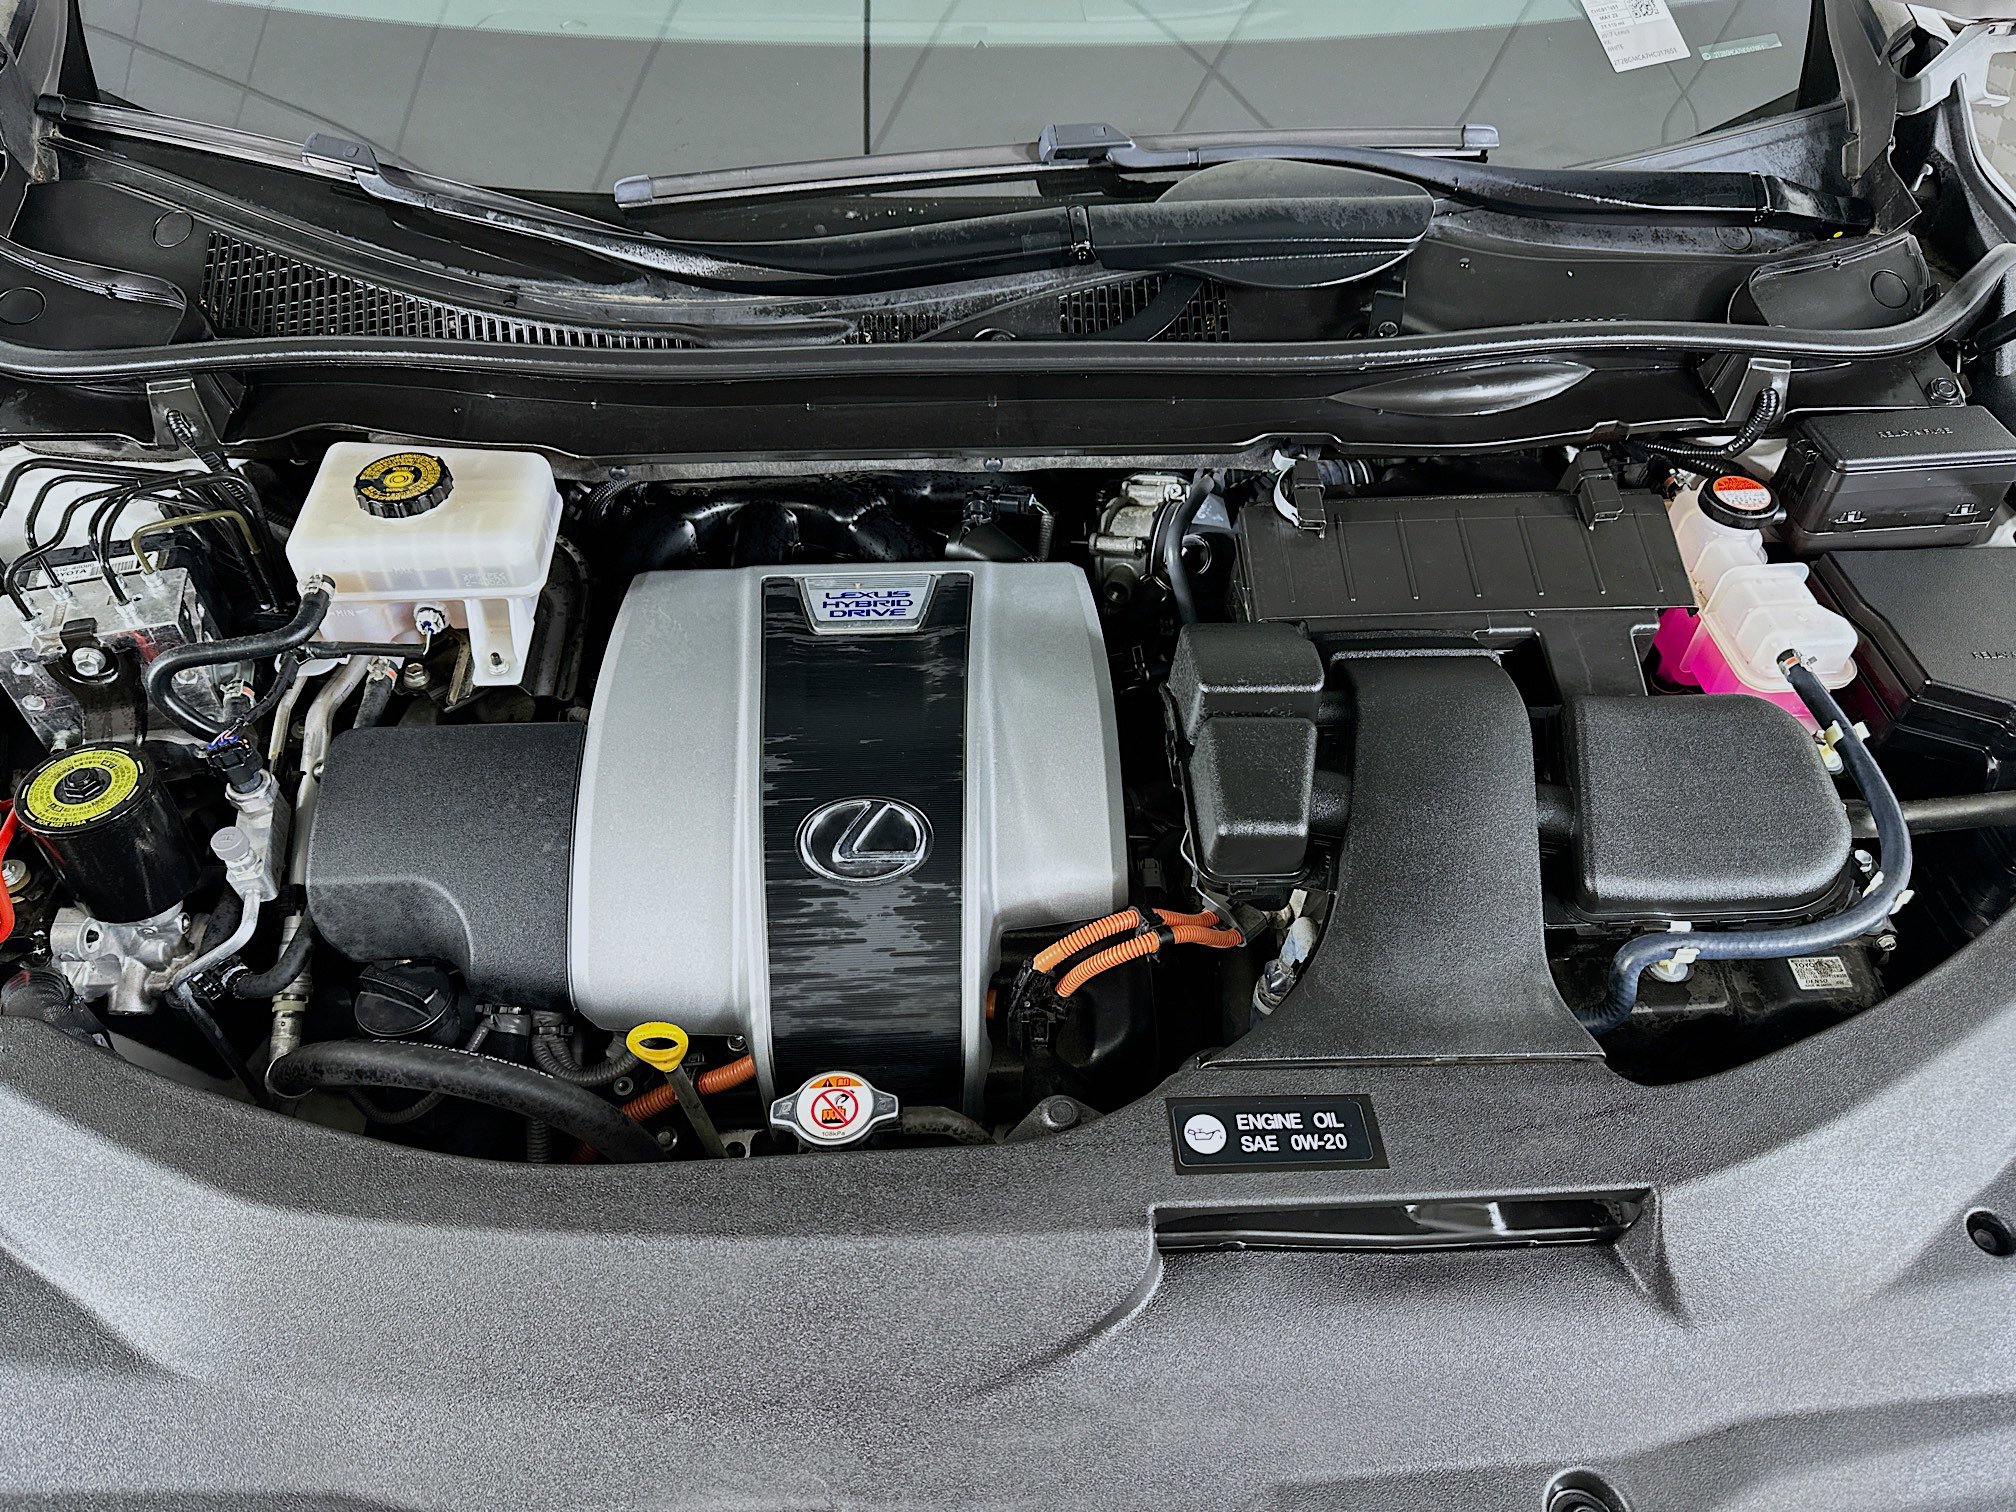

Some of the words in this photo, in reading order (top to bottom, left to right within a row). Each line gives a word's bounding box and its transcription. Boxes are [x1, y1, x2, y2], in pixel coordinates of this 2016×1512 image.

[825, 590, 911, 599] LEXUS
[822, 599, 914, 609] HYBRID
[829, 608, 907, 618] DRIVE
[1235, 1112, 1304, 1130] ENGINE
[1312, 1111, 1345, 1129] OIL
[1240, 1134, 1280, 1153] SAE
[1290, 1132, 1348, 1151] 0W-20
